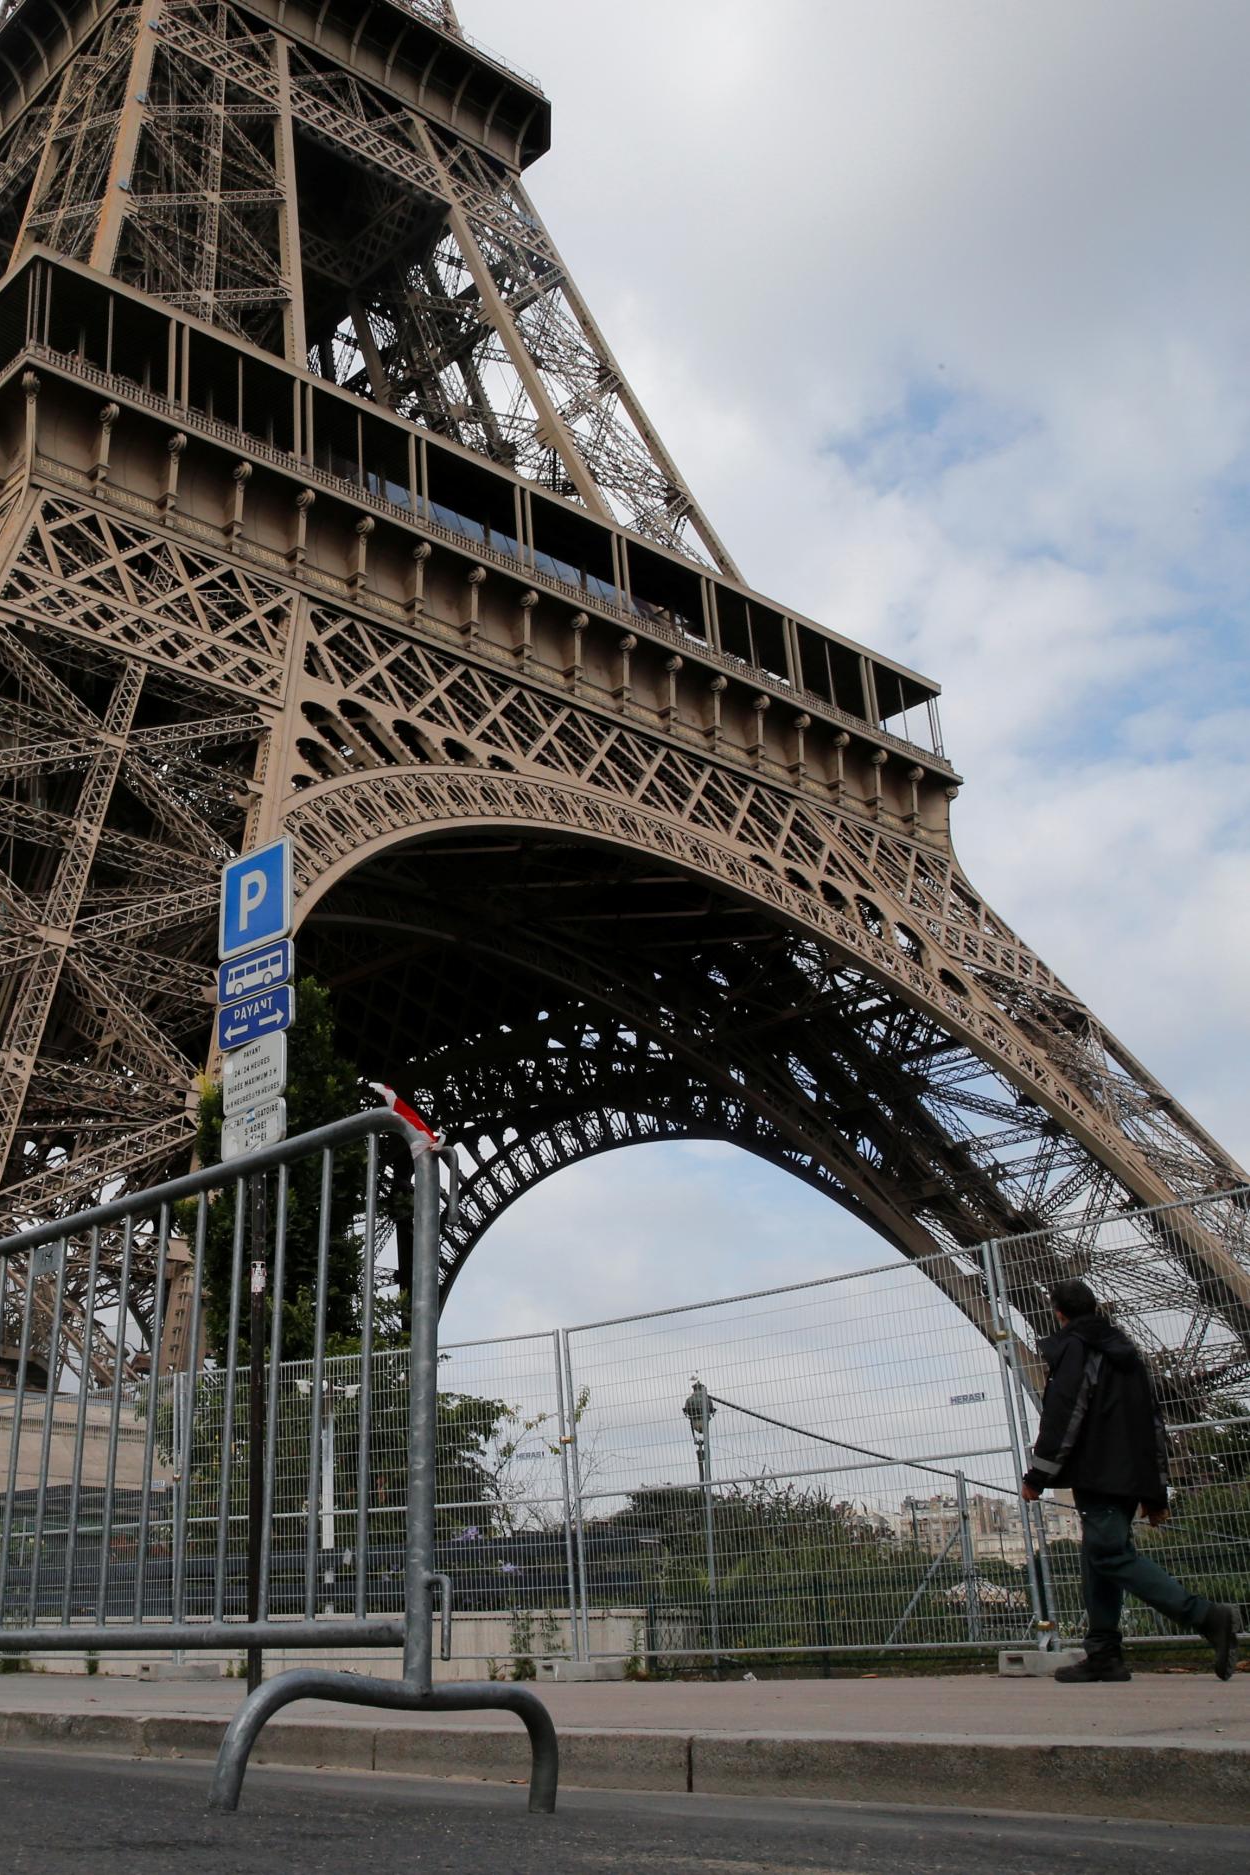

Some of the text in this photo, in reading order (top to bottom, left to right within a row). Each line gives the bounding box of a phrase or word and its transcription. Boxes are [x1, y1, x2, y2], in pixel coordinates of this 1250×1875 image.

[238, 869, 268, 932] P
[234, 996, 273, 1020] PAYANT
[243, 1045, 261, 1058] PAYANT
[250, 1055, 270, 1069] HEURES
[244, 1071, 268, 1087] MAXIMUM
[261, 1081, 279, 1095] HEURES
[950, 1392, 981, 1405] HERAS
